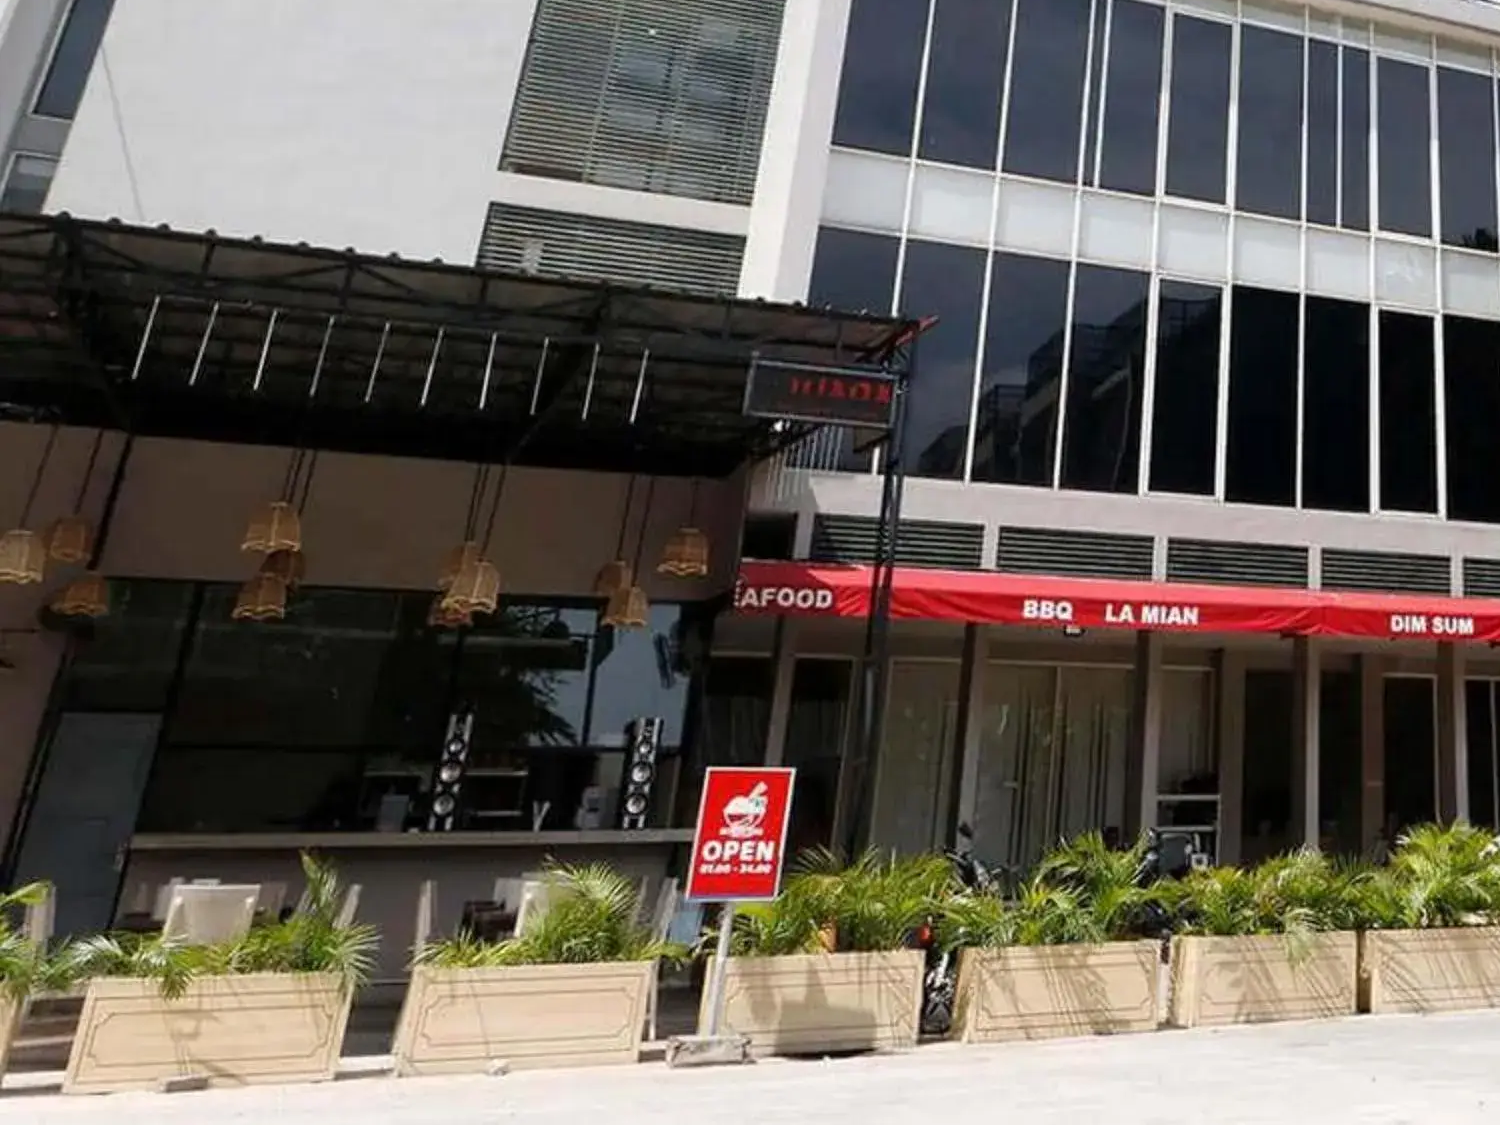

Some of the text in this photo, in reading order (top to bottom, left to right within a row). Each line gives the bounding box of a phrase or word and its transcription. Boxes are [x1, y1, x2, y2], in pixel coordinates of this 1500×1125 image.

[1023, 599, 1073, 620] BBQ
[1105, 603, 1199, 625] LA MIAN
[1391, 615, 1474, 635] DIM SUM
[702, 840, 775, 861] OPEN
